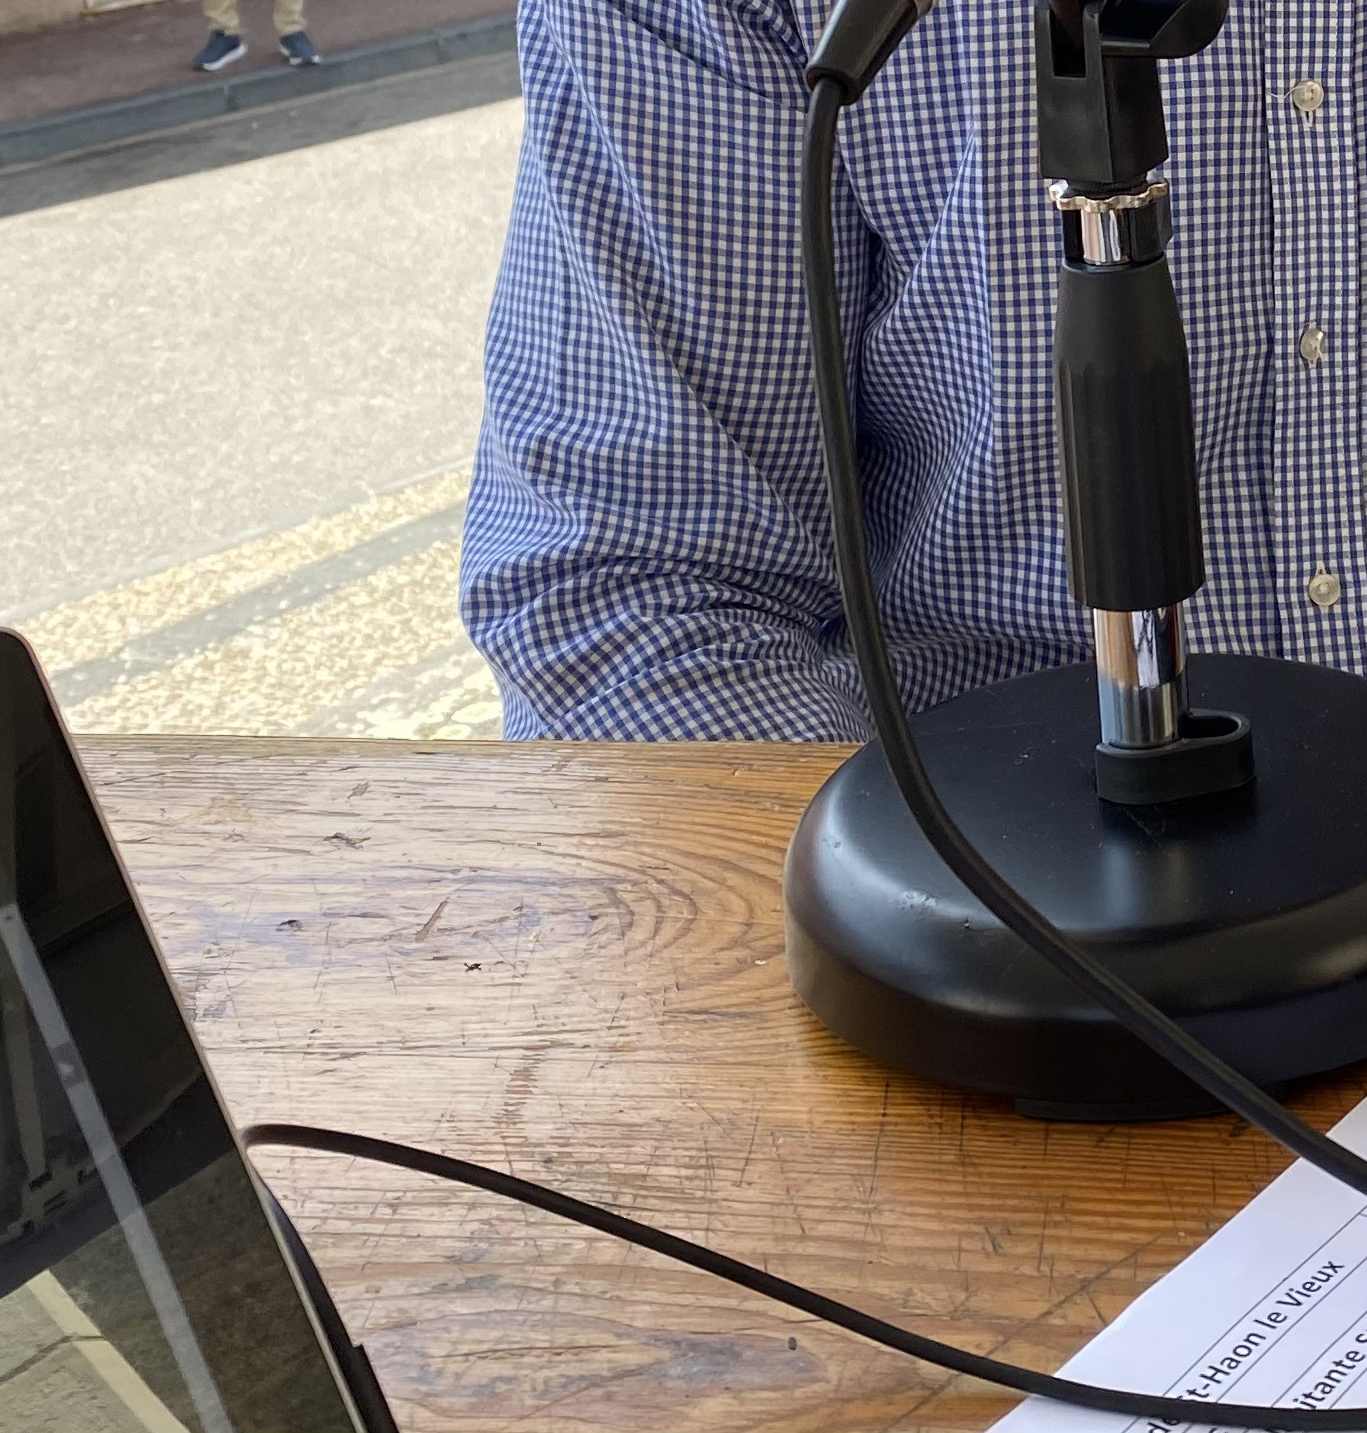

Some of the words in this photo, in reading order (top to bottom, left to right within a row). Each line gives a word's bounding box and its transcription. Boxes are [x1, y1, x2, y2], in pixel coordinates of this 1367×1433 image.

[1177, 1332, 1266, 1401] t-Haon
[1253, 1311, 1288, 1330] le
[1275, 1260, 1345, 1309] Vieux
[1293, 1349, 1366, 1411] itante
